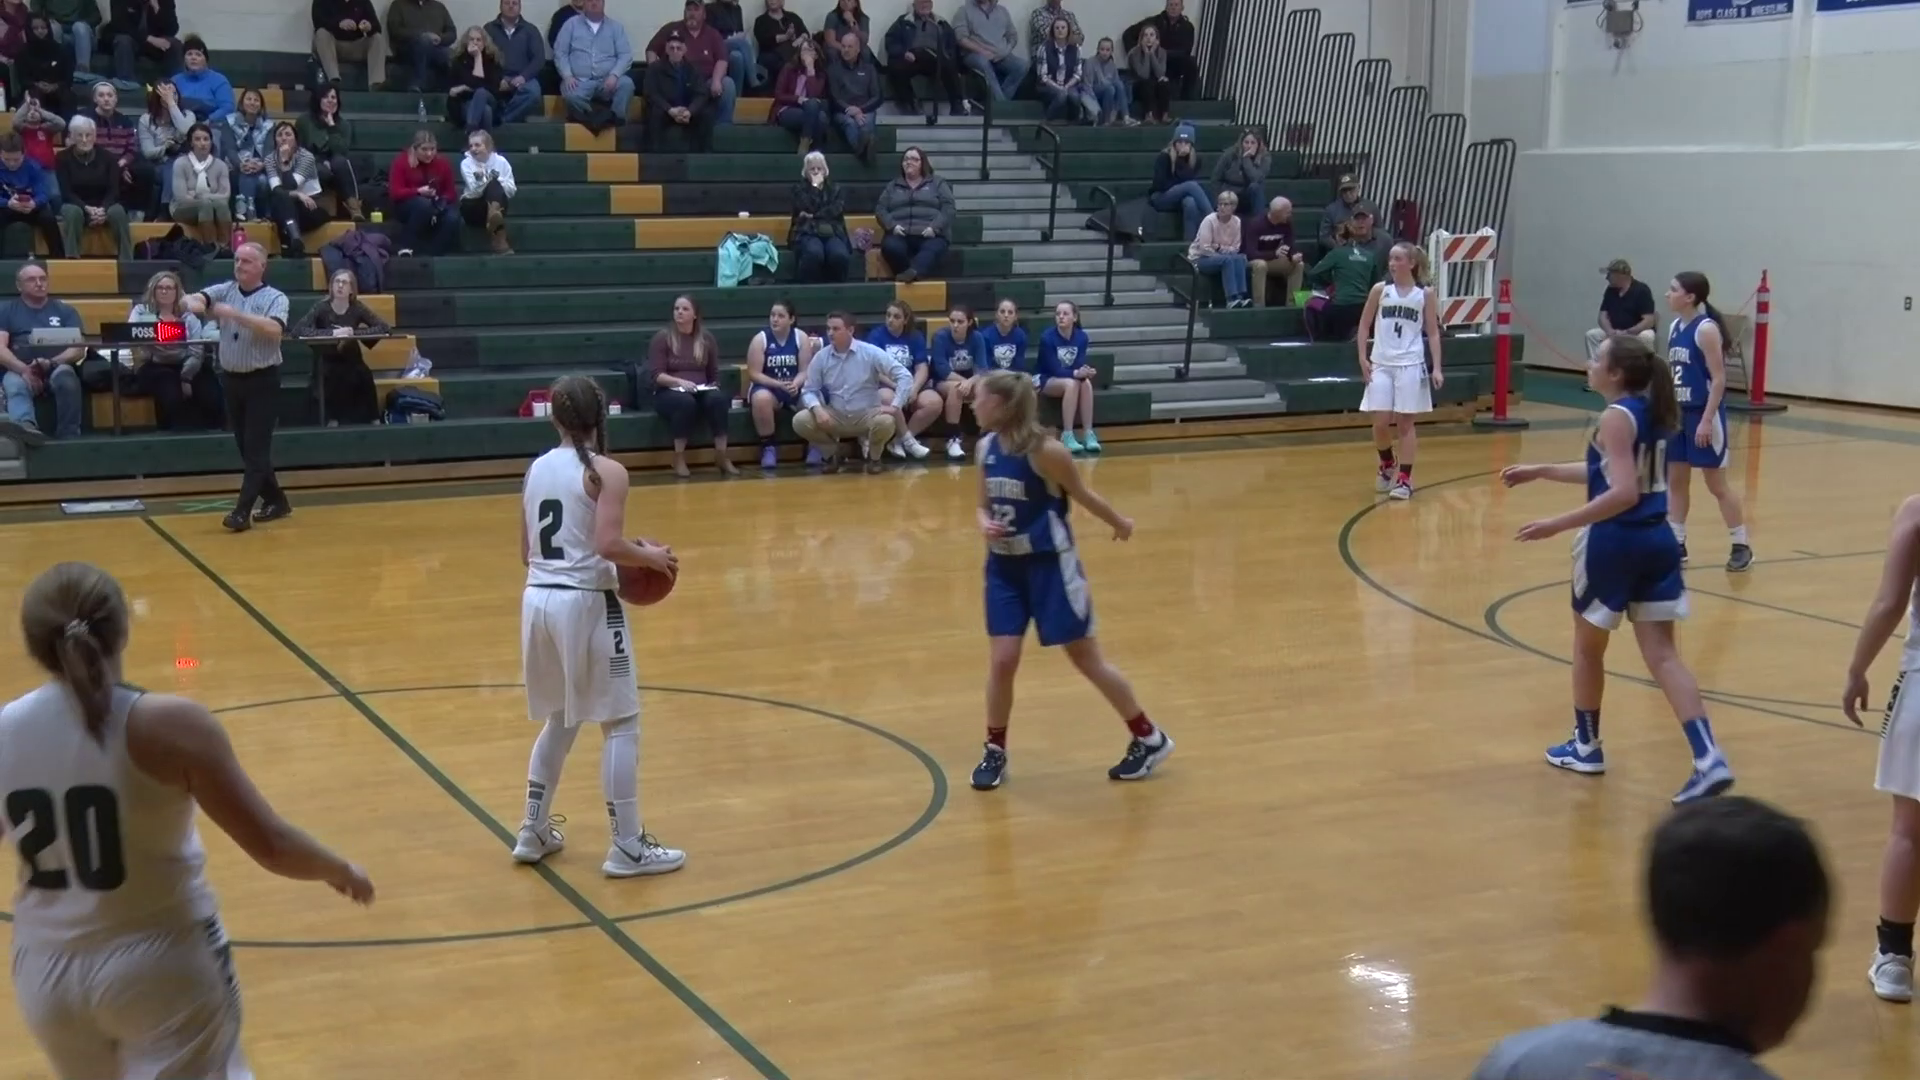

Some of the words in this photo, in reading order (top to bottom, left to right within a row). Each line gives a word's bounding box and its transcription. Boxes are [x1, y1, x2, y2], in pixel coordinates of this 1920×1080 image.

[1716, 8, 1738, 19] CLASS
[1381, 305, 1420, 323] WARRIORS
[131, 326, 157, 338] POSS.
[1393, 321, 1403, 339] 4
[767, 354, 798, 367] CENTRAL
[538, 498, 565, 560] 2
[613, 629, 625, 655] 2
[6, 784, 128, 891] 20
